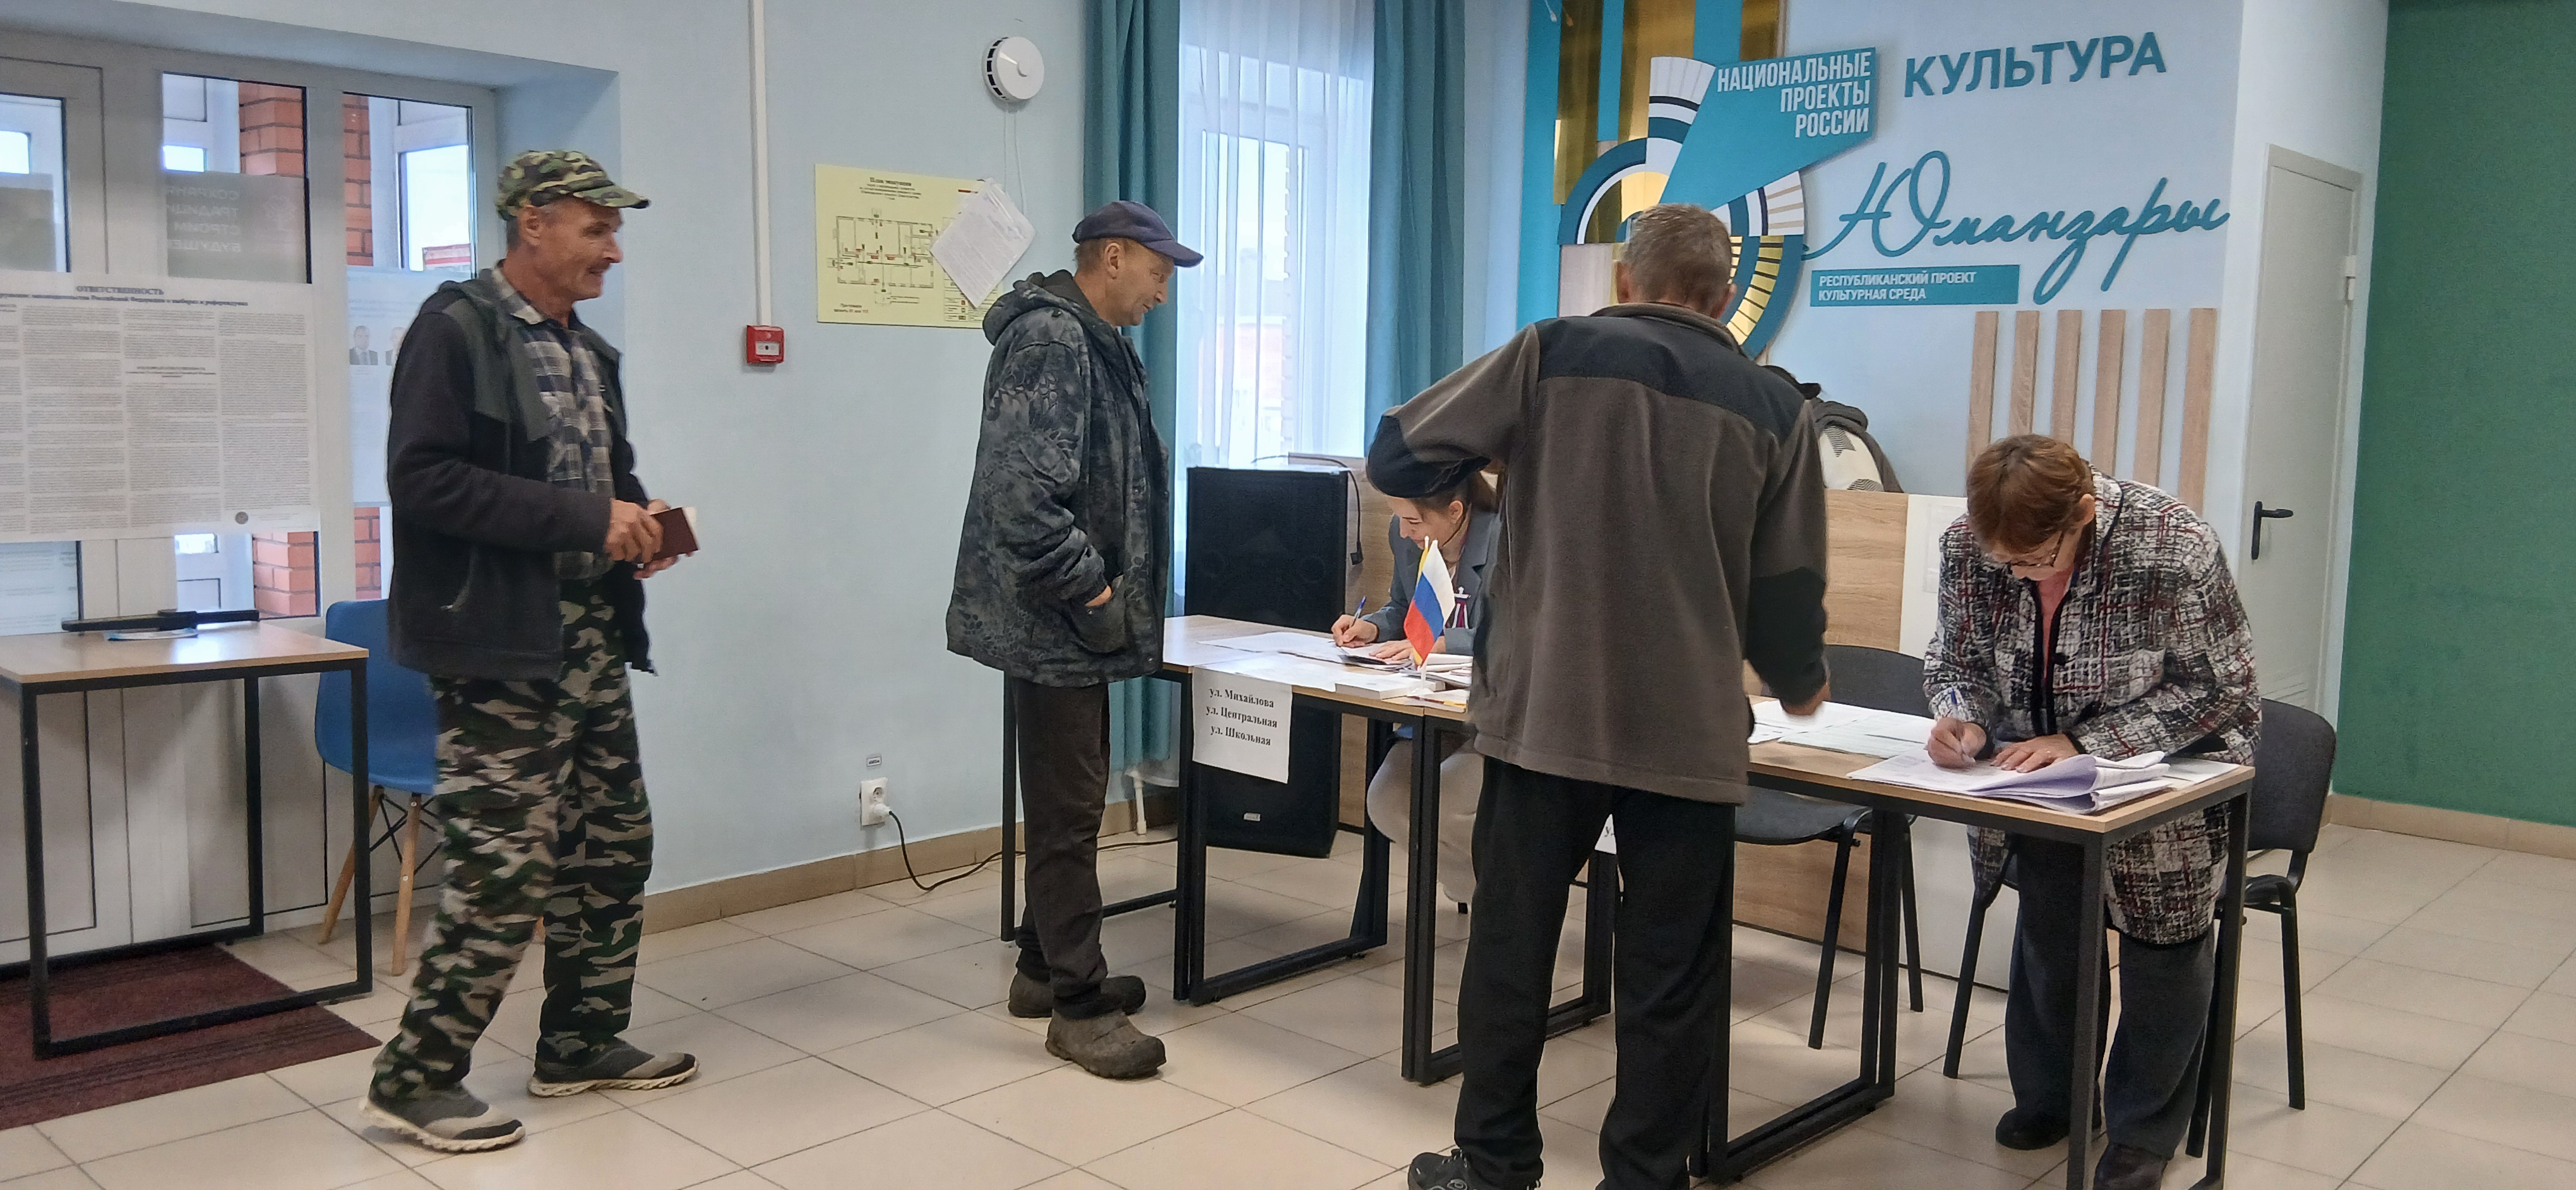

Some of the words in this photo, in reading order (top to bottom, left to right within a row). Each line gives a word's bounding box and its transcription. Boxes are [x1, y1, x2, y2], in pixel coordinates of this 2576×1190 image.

[1717, 52, 1871, 92] НАЦИОНАЛЬНЫЕ
[1904, 32, 2166, 97] КУЛЬТУРА
[1780, 80, 1869, 112] ПРОЕКТЫ
[1795, 107, 1869, 138] РОССИИ
[1801, 150, 2230, 305] Юманзары
[1819, 270, 1928, 287] РЕСПУБЛИКАНСКИЙ
[1931, 272, 1977, 284] ПРОЕКТ
[1818, 289, 1887, 301] КУЛЬТУРНАЯ
[1888, 288, 1926, 301] СРЕДА
[1208, 688, 1222, 698] ул.
[1225, 689, 1274, 708] Михайлова
[1206, 706, 1219, 716] ул.
[1220, 706, 1277, 728] Центральная
[1210, 726, 1223, 736] ул.
[1225, 727, 1271, 746] Школьная
